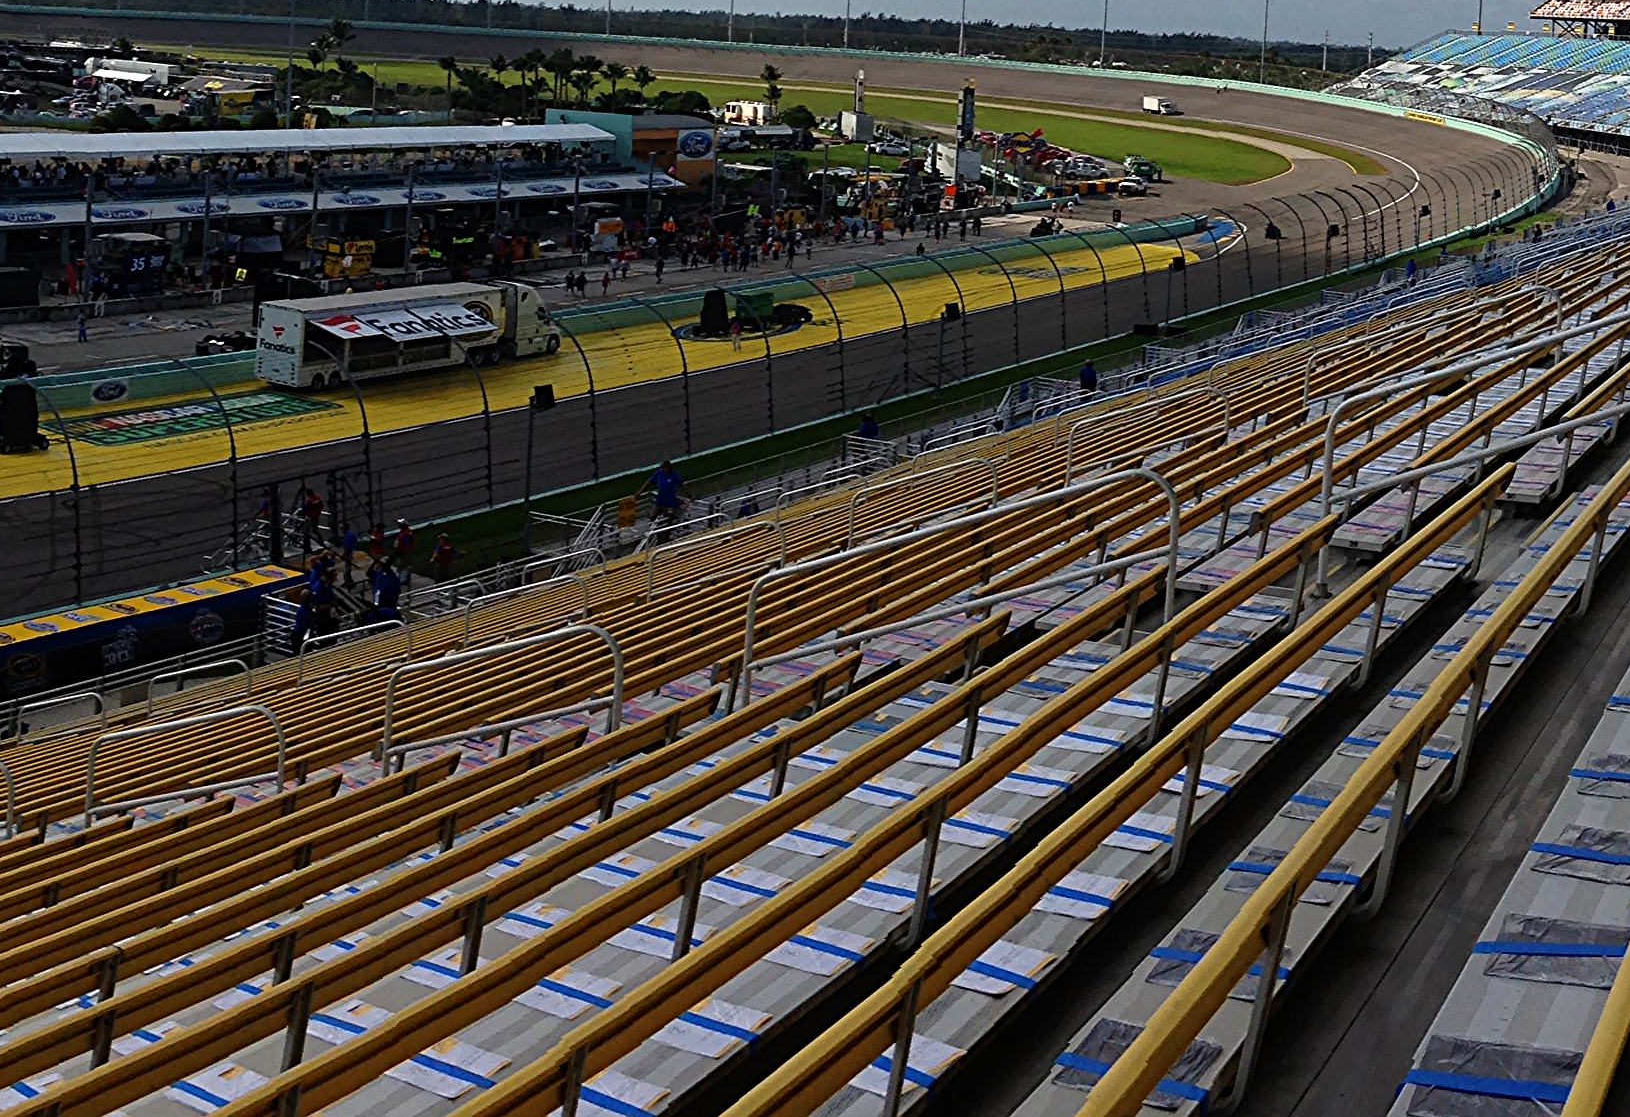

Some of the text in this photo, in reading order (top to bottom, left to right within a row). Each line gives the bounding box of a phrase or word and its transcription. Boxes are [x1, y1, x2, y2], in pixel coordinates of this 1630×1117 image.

[130, 256, 146, 272] 35
[373, 309, 486, 340] Fanatics
[260, 339, 296, 355] Fanatics
